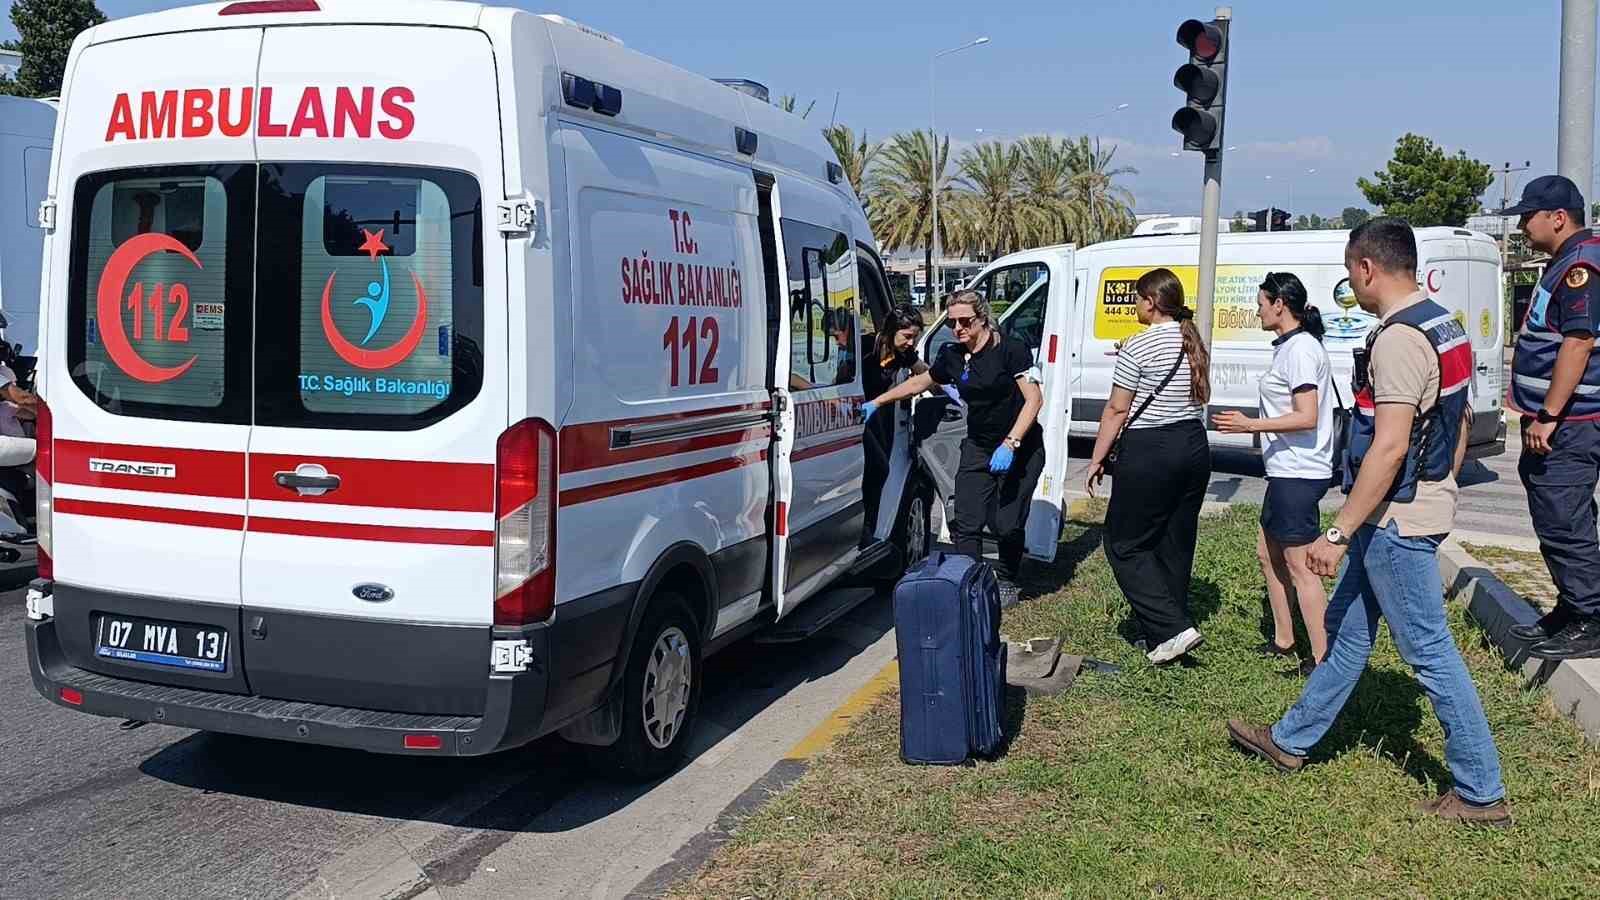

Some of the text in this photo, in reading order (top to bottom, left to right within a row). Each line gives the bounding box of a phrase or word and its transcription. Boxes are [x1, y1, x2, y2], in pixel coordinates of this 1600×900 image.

[105, 86, 415, 142] AMBULANS
[669, 208, 699, 255] T.C.
[621, 250, 743, 309] SAĞLIK BAKANLIĞI
[127, 282, 190, 342] 112
[1104, 306, 1121, 316] 444
[1105, 294, 1137, 303] biodi
[1231, 294, 1259, 304] KİRLE
[1218, 306, 1262, 329] DÖKM
[663, 316, 721, 387] 112
[298, 375, 450, 400] T.C. Sağlık Bakanlığı
[90, 460, 175, 477] TRANSIT
[108, 620, 133, 648] 07
[143, 624, 178, 654] MVA
[196, 631, 220, 659] 13
